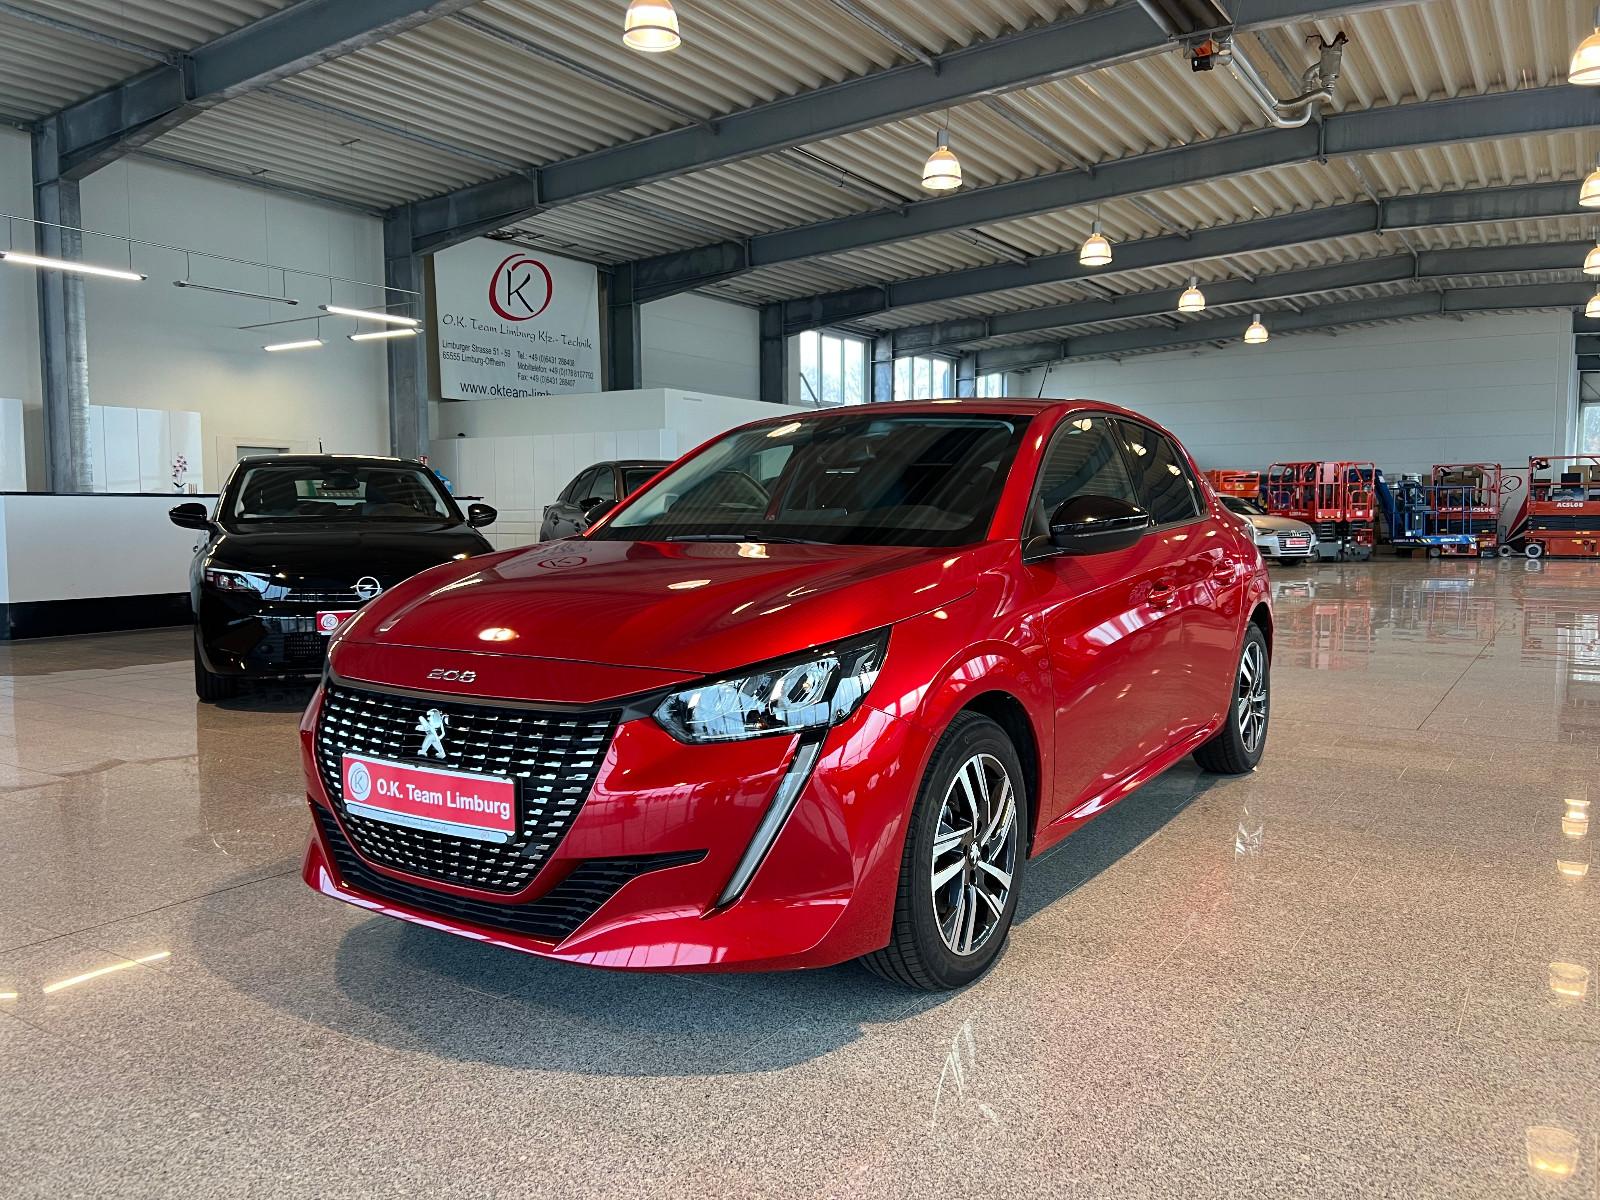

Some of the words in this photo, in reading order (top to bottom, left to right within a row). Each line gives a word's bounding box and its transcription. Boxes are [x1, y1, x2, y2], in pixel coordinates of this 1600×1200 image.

[443, 314, 467, 328] O.K.
[470, 318, 497, 333] Team
[499, 323, 536, 343] Limburg
[561, 334, 592, 349] Technik
[442, 340, 470, 352] Limburger
[471, 343, 492, 355] Strasse
[459, 382, 553, 398] www.okteam-limb
[426, 668, 476, 683] 208
[376, 778, 403, 799] O.K.
[405, 783, 443, 803] Team
[446, 790, 511, 820] Limburg
